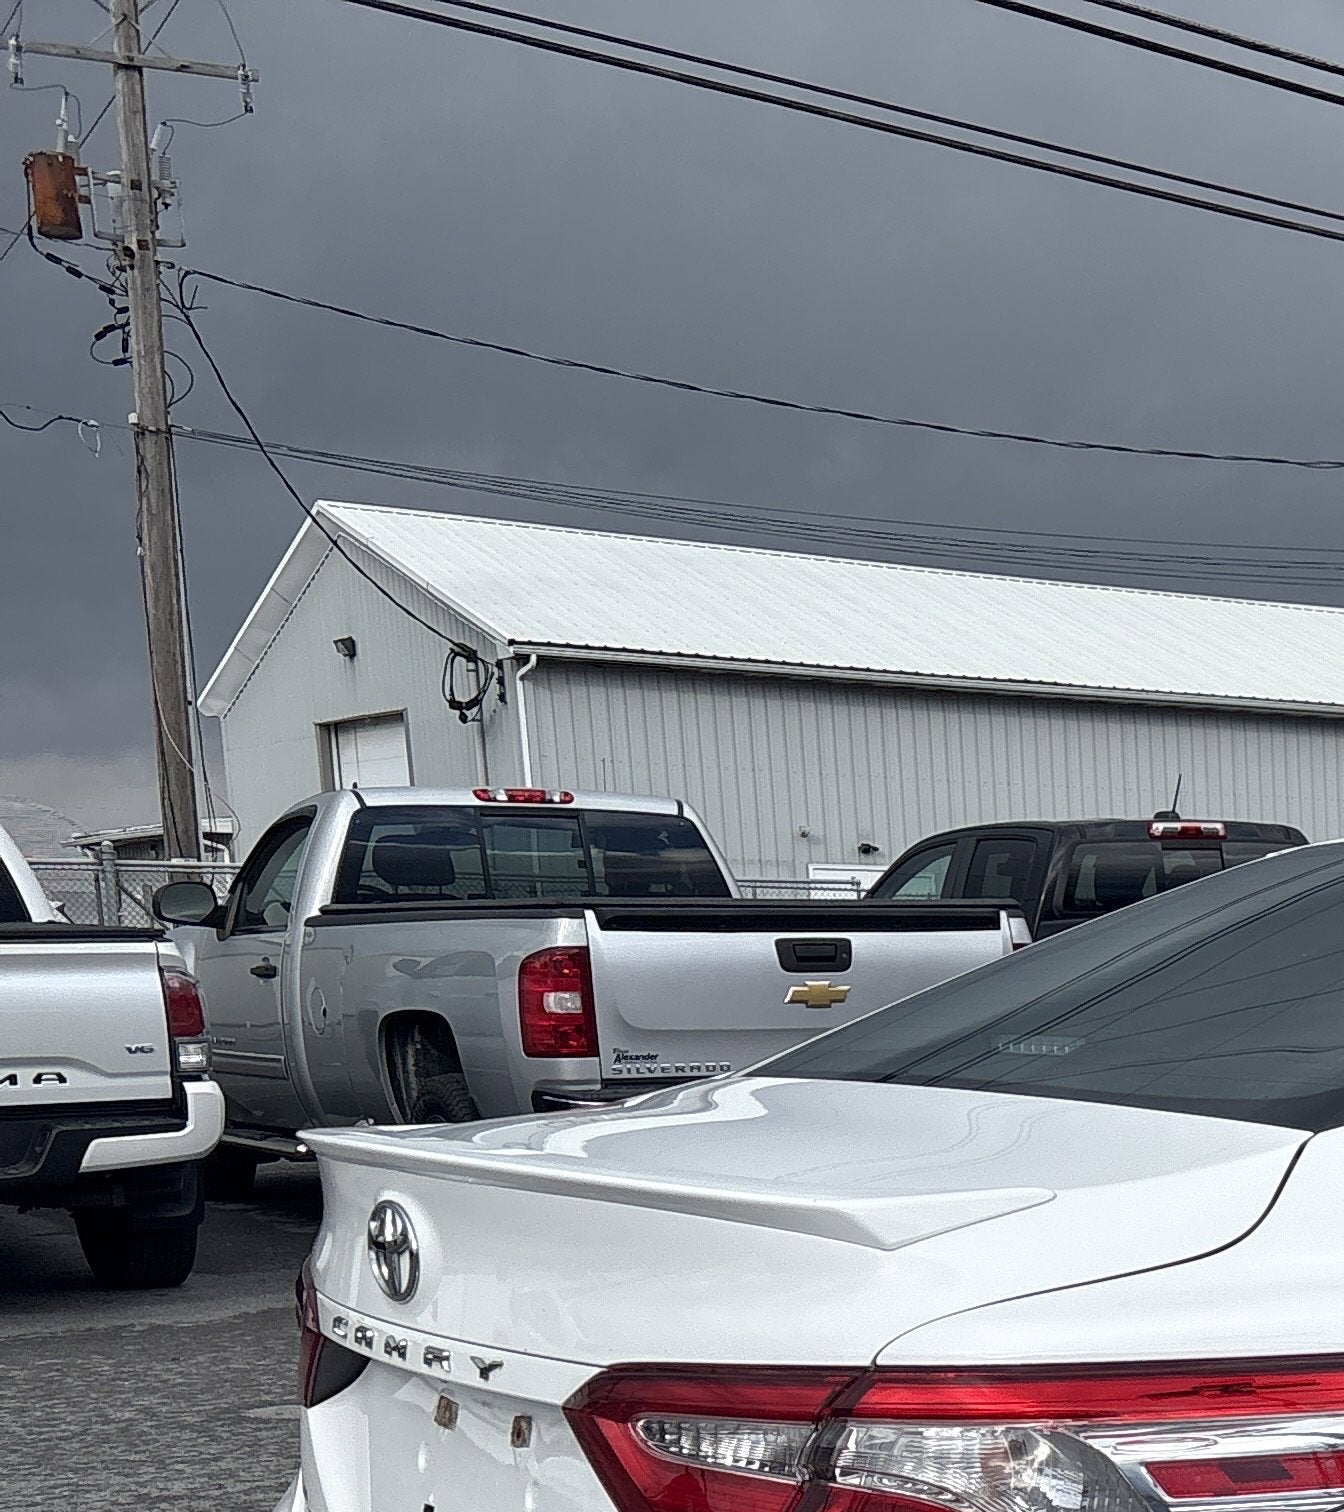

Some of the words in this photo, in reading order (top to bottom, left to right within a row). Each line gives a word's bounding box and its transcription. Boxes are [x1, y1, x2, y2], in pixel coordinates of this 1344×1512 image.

[124, 1043, 155, 1055] V6
[612, 1052, 660, 1064] Alexander
[611, 1061, 731, 1076] SILVERADO
[332, 1315, 505, 1382] CAMRY
